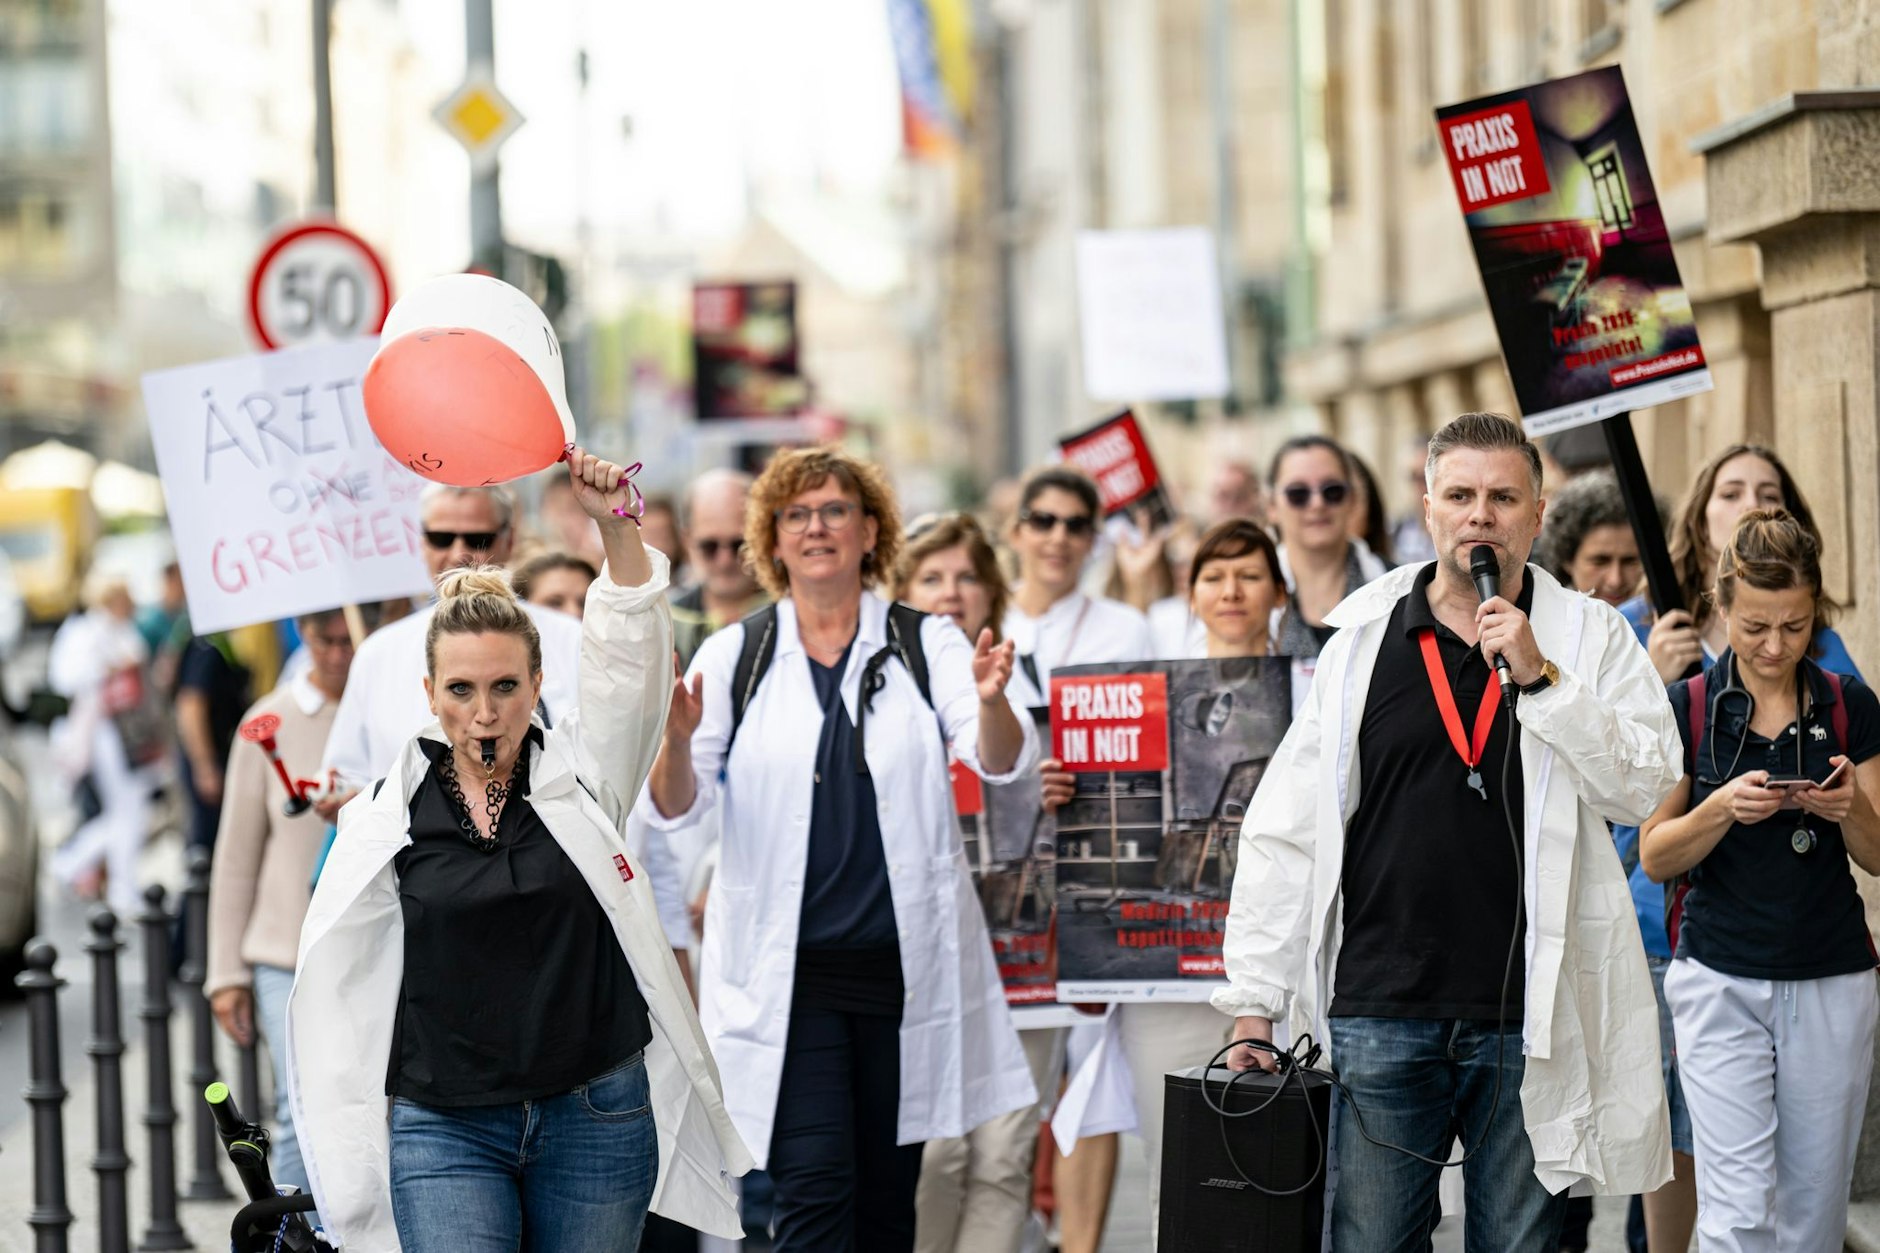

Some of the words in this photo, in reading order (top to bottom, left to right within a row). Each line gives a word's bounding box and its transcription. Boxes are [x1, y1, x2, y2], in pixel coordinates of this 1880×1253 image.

[1450, 113, 1519, 161] PRAXIS
[1461, 165, 1488, 203] IN
[1485, 155, 1526, 197] NOT
[280, 263, 366, 340] 50
[202, 376, 372, 484] ÄRZT
[1061, 682, 1144, 720] PRAXIS
[1062, 727, 1088, 763] IN
[1093, 726, 1142, 762] NOT
[1200, 1178, 1249, 1190] BOSE
